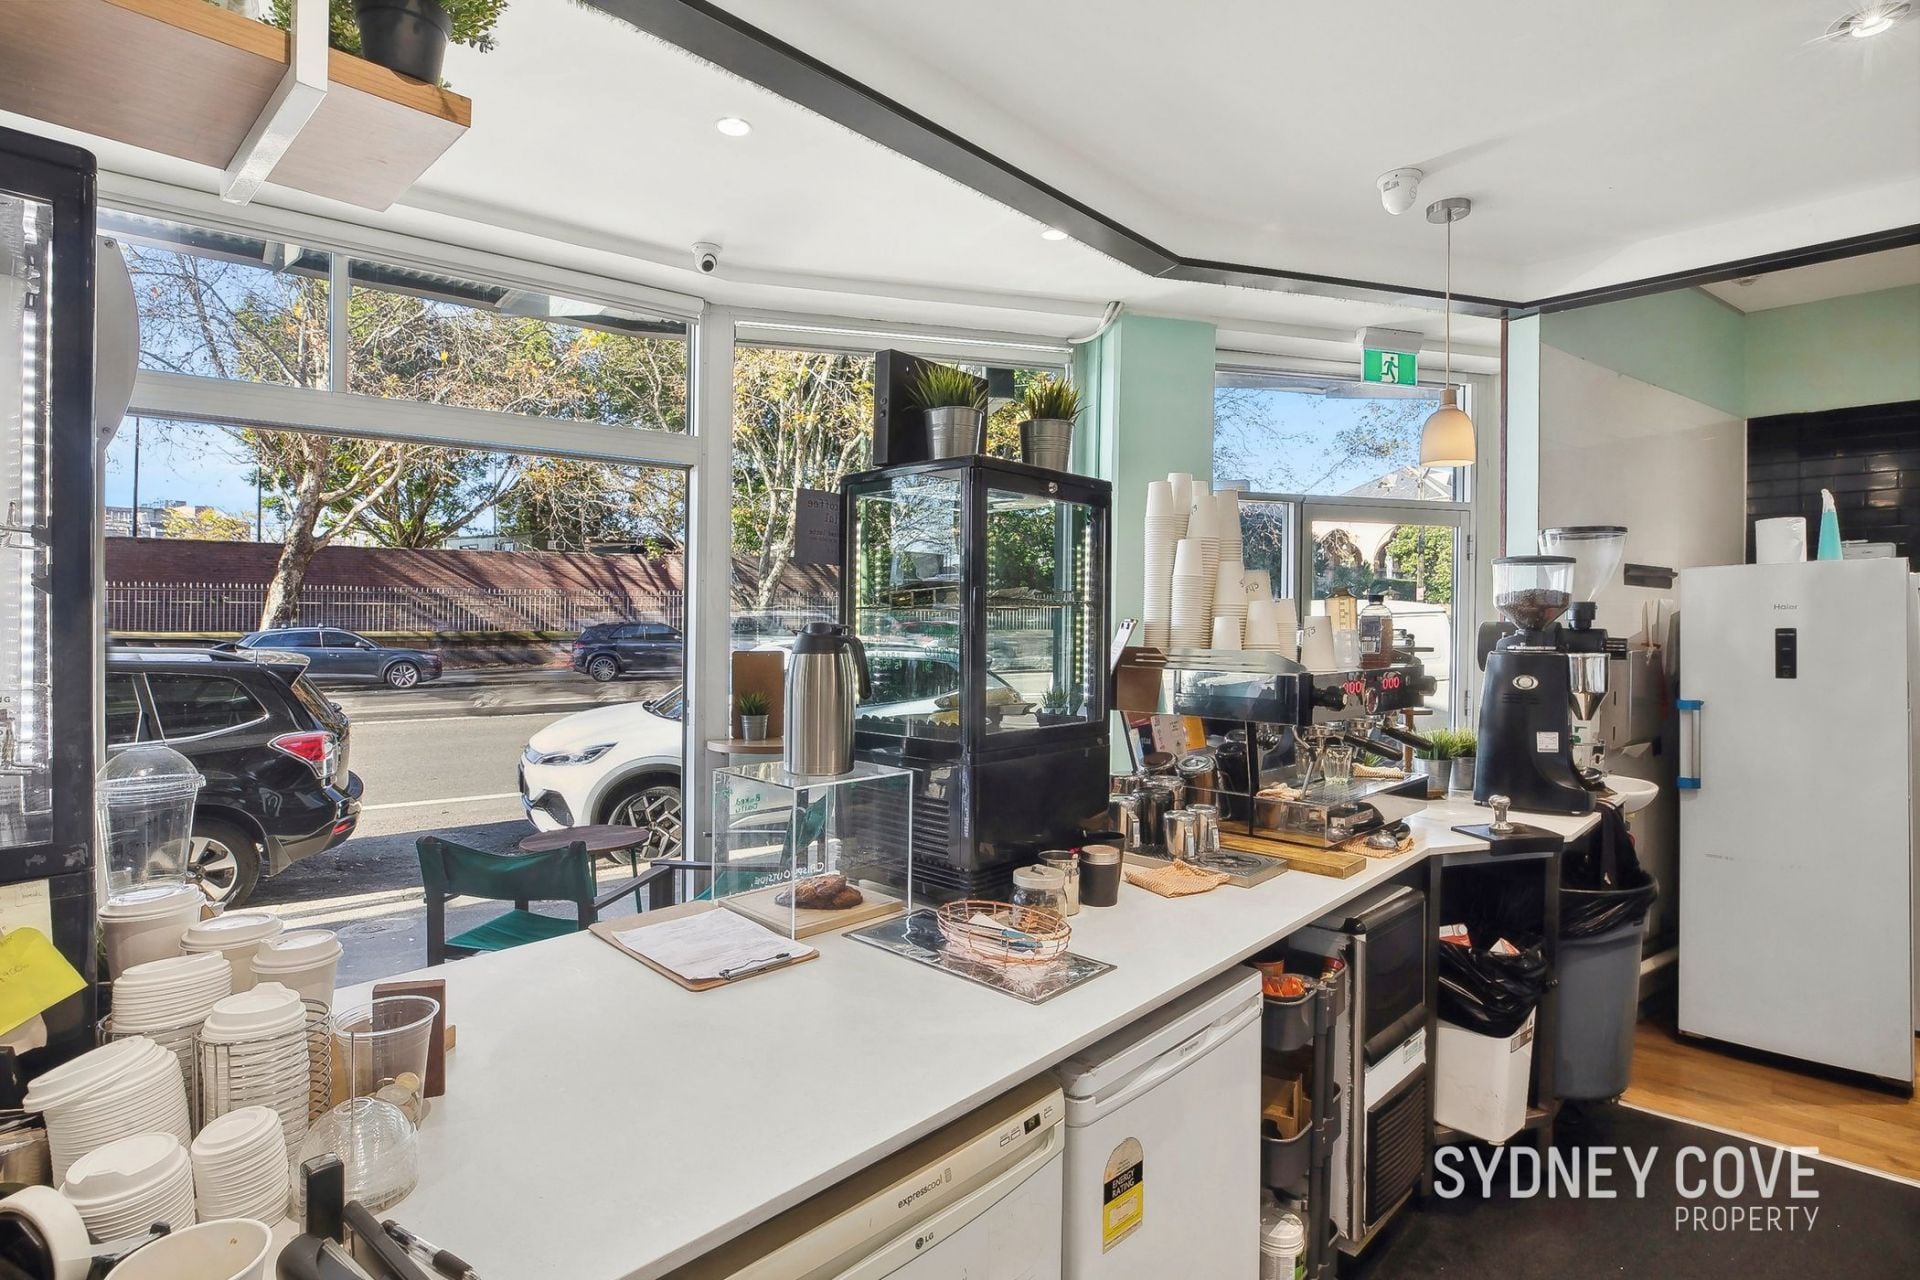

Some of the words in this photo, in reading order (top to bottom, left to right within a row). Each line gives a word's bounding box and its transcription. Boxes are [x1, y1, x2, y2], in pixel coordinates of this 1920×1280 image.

[1111, 1168, 1135, 1190] ENERGY
[1111, 1178, 1136, 1199] RATING
[897, 1173, 943, 1209] expresscool
